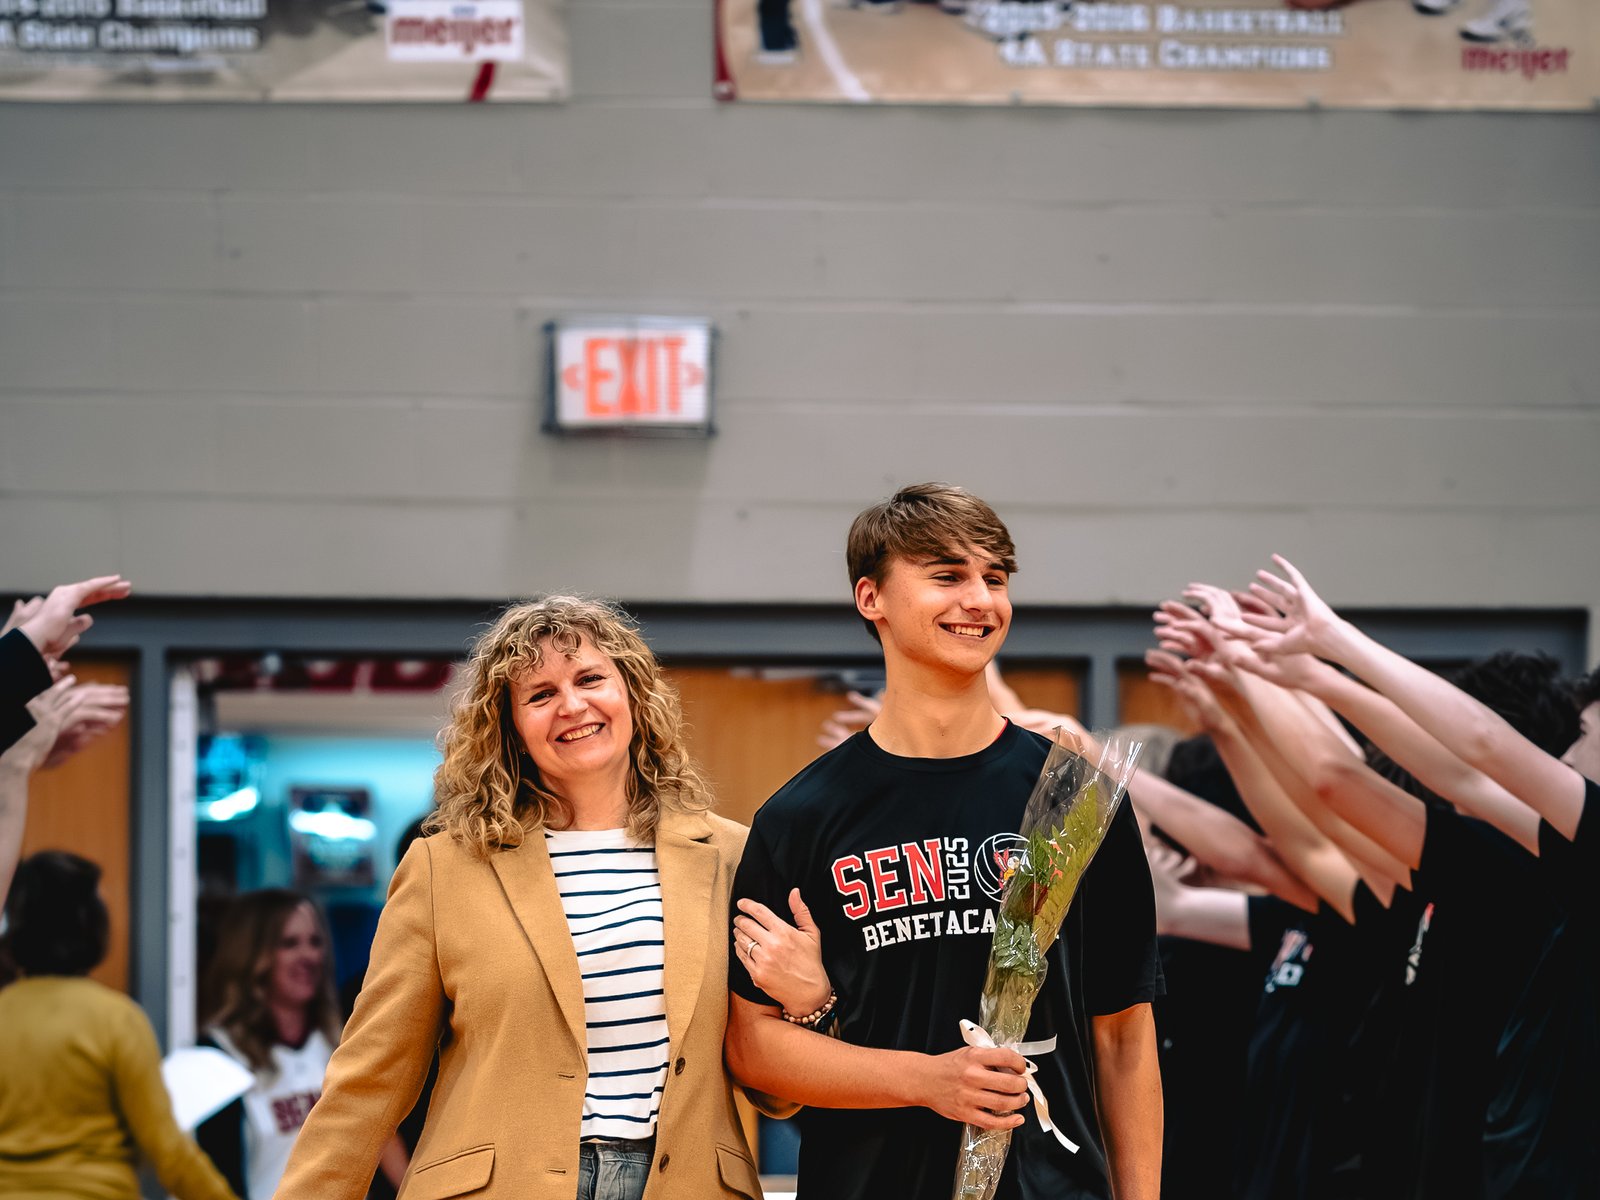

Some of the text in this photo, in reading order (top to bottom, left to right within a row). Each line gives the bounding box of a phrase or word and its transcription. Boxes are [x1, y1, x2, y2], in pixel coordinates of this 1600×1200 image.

[18, 20, 95, 48] State
[100, 20, 260, 52] Champions
[393, 6, 512, 54] meijer
[1157, 6, 1343, 34] BASKETBALL
[1054, 39, 1148, 67] STATE
[1158, 40, 1330, 68] CHAMPIONS
[1462, 47, 1568, 80] meijer
[585, 338, 686, 416] EXIT
[831, 837, 946, 920] SEN
[943, 836, 970, 900] 2025
[862, 908, 997, 951] BENETACA
